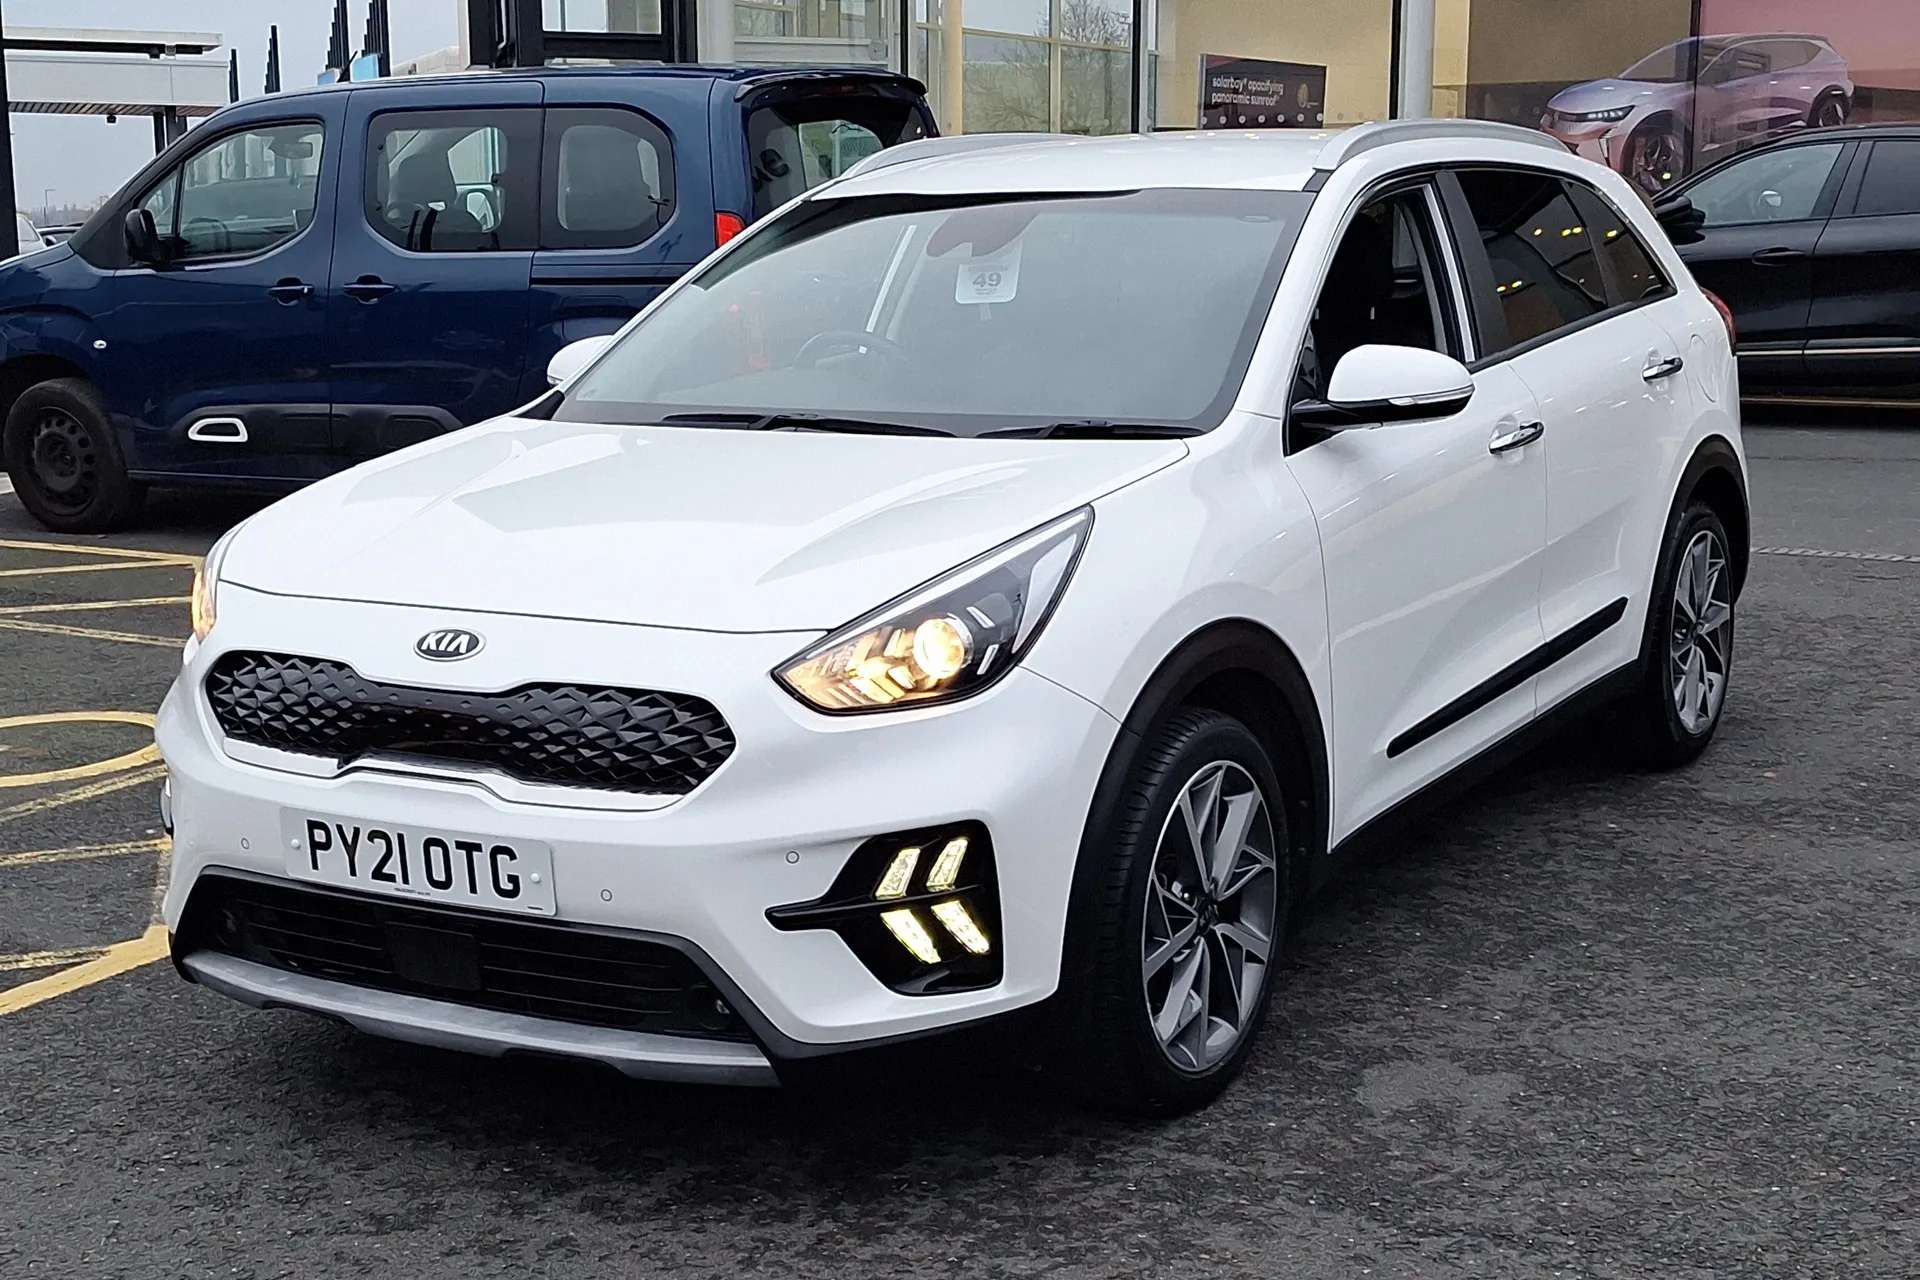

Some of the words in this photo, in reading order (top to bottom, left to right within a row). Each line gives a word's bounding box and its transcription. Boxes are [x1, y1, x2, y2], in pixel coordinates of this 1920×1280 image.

[1211, 91, 1250, 105] panoramic
[972, 271, 1002, 288] 49
[420, 631, 470, 654] KIA
[306, 819, 410, 885] PY21
[422, 836, 522, 899] OTG
